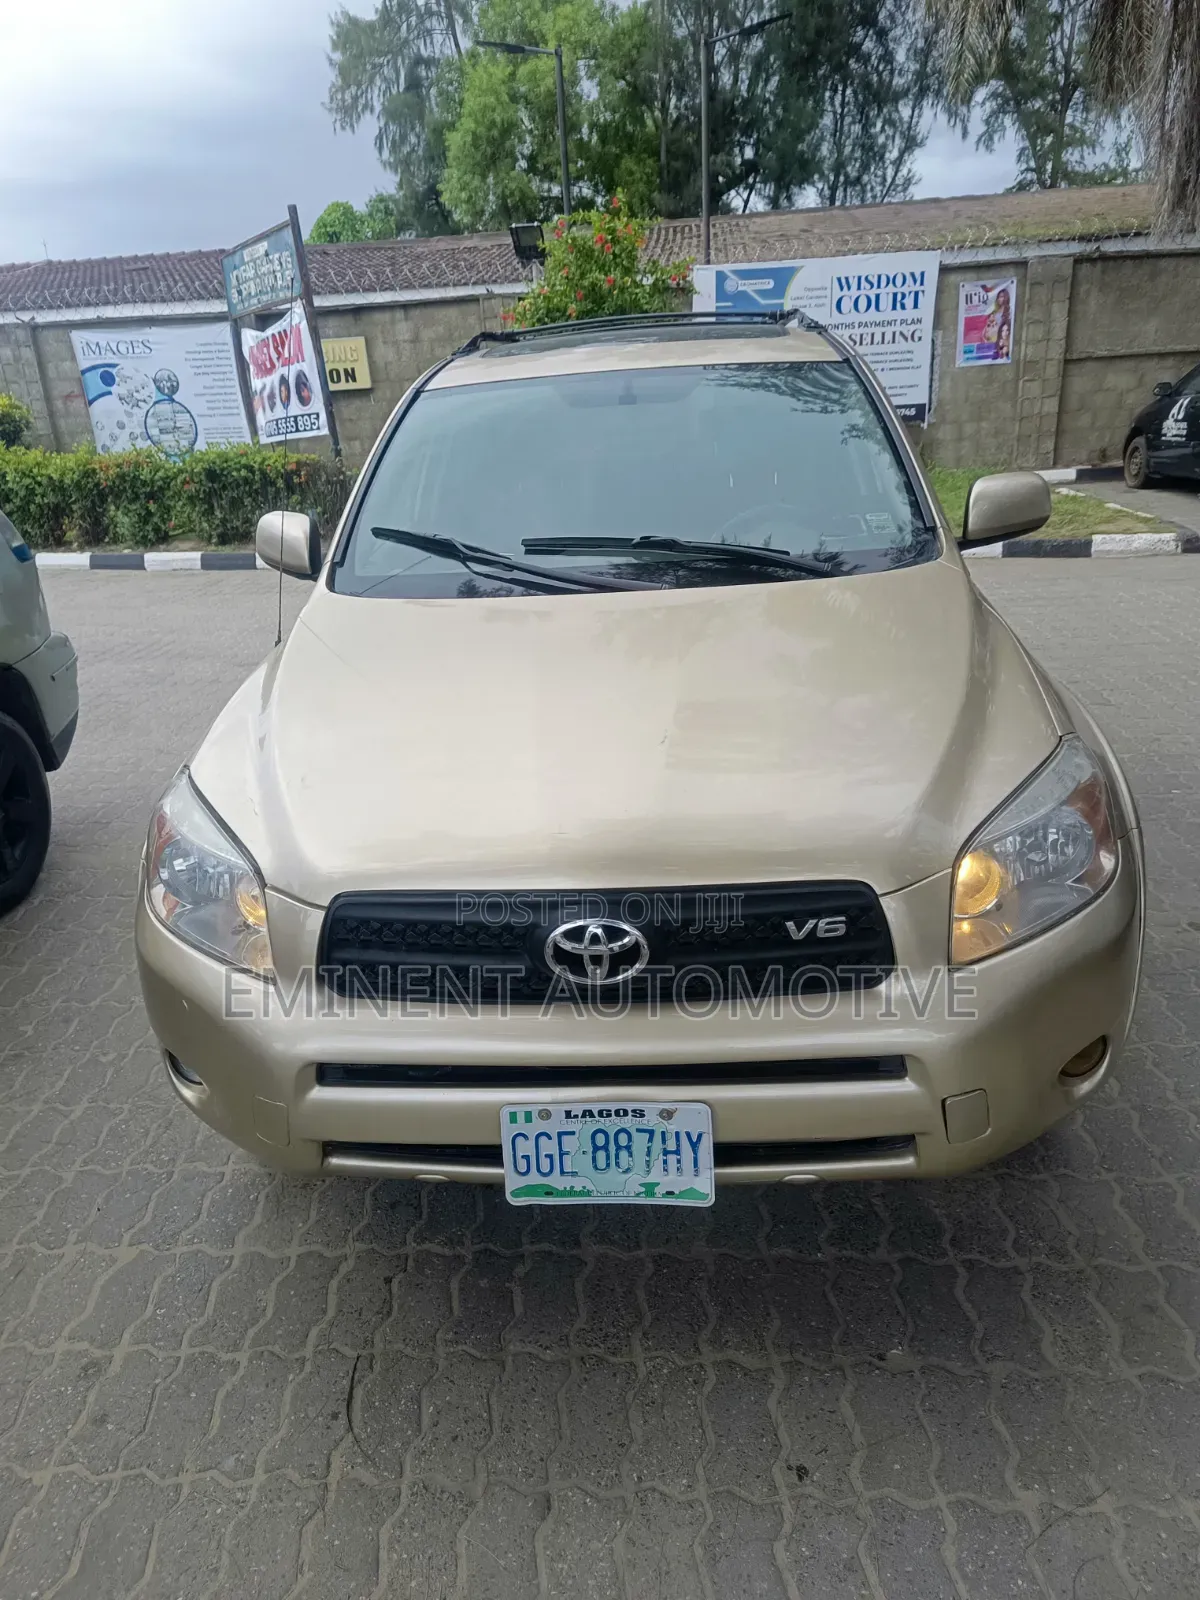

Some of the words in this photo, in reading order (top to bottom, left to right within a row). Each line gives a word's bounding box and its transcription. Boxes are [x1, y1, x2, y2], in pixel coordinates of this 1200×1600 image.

[836, 270, 926, 292] WISDOM
[835, 290, 925, 315] COURT
[858, 319, 898, 329] PAYMENT
[899, 317, 923, 326] PLAN
[848, 328, 923, 347] SELLING
[325, 344, 359, 363] ING
[298, 414, 319, 430] 895
[785, 916, 848, 940] V6
[564, 1108, 646, 1119] LAGOS
